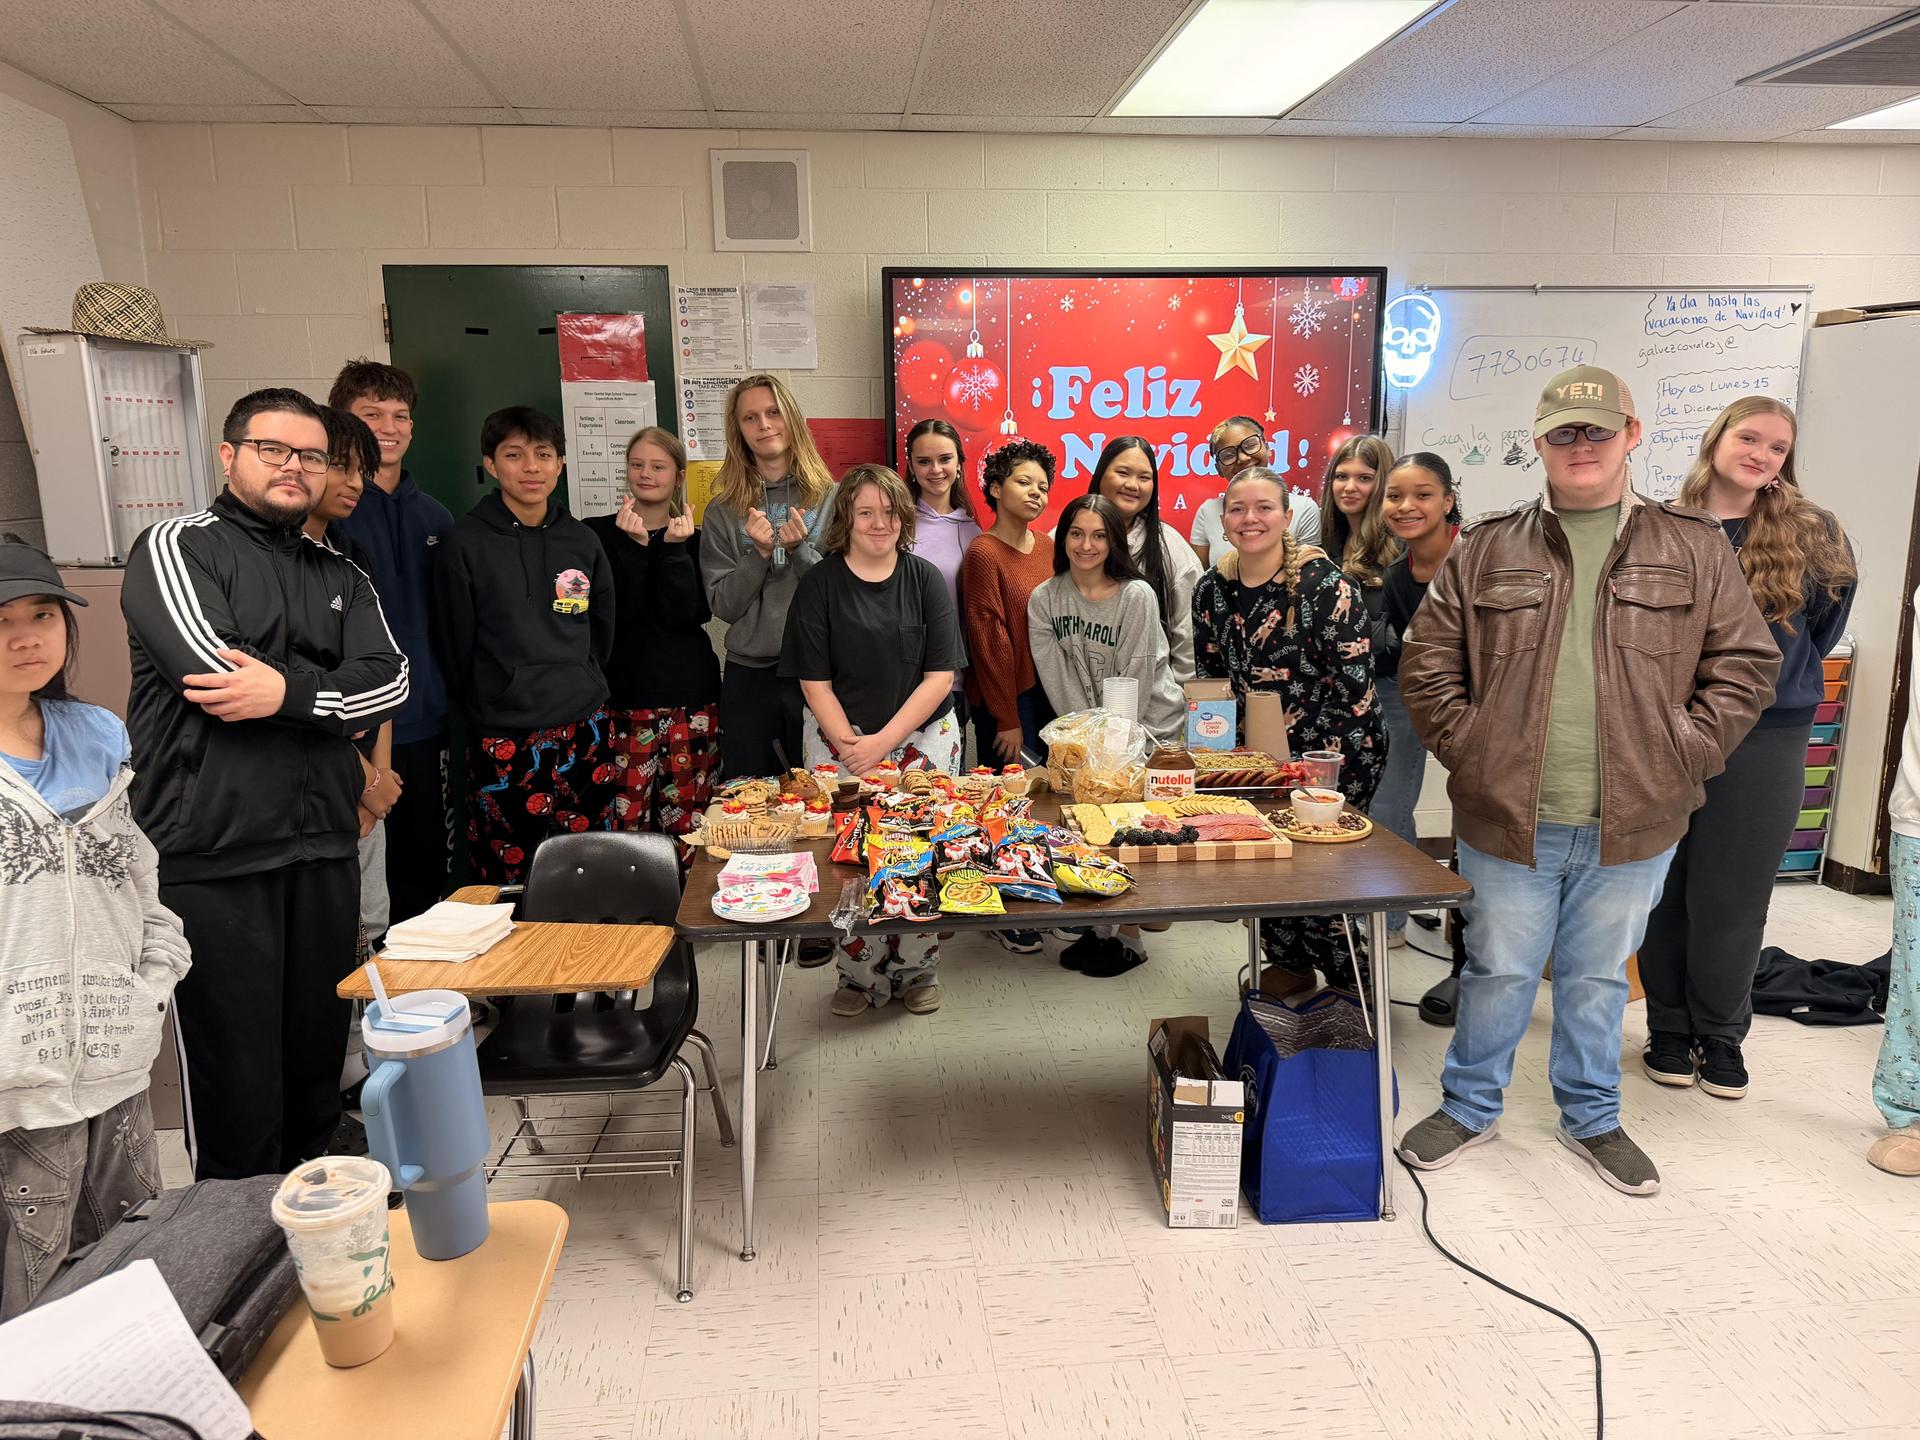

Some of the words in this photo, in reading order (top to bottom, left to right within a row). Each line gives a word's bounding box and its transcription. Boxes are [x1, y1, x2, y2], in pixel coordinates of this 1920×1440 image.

[1743, 293, 1761, 307] las
[1714, 310, 1727, 322] de
[1468, 346, 1584, 384] 7780674
[702, 377, 742, 385] EMERGENCY
[1662, 382, 1685, 399] Hoy
[1689, 386, 1704, 394] es
[1753, 377, 1769, 389] 15
[1031, 365, 1202, 420] ¡Feliz
[1556, 382, 1603, 399] YETI
[1659, 403, 1678, 417] de
[1471, 424, 1489, 442] la
[1151, 774, 1192, 785] nutella
